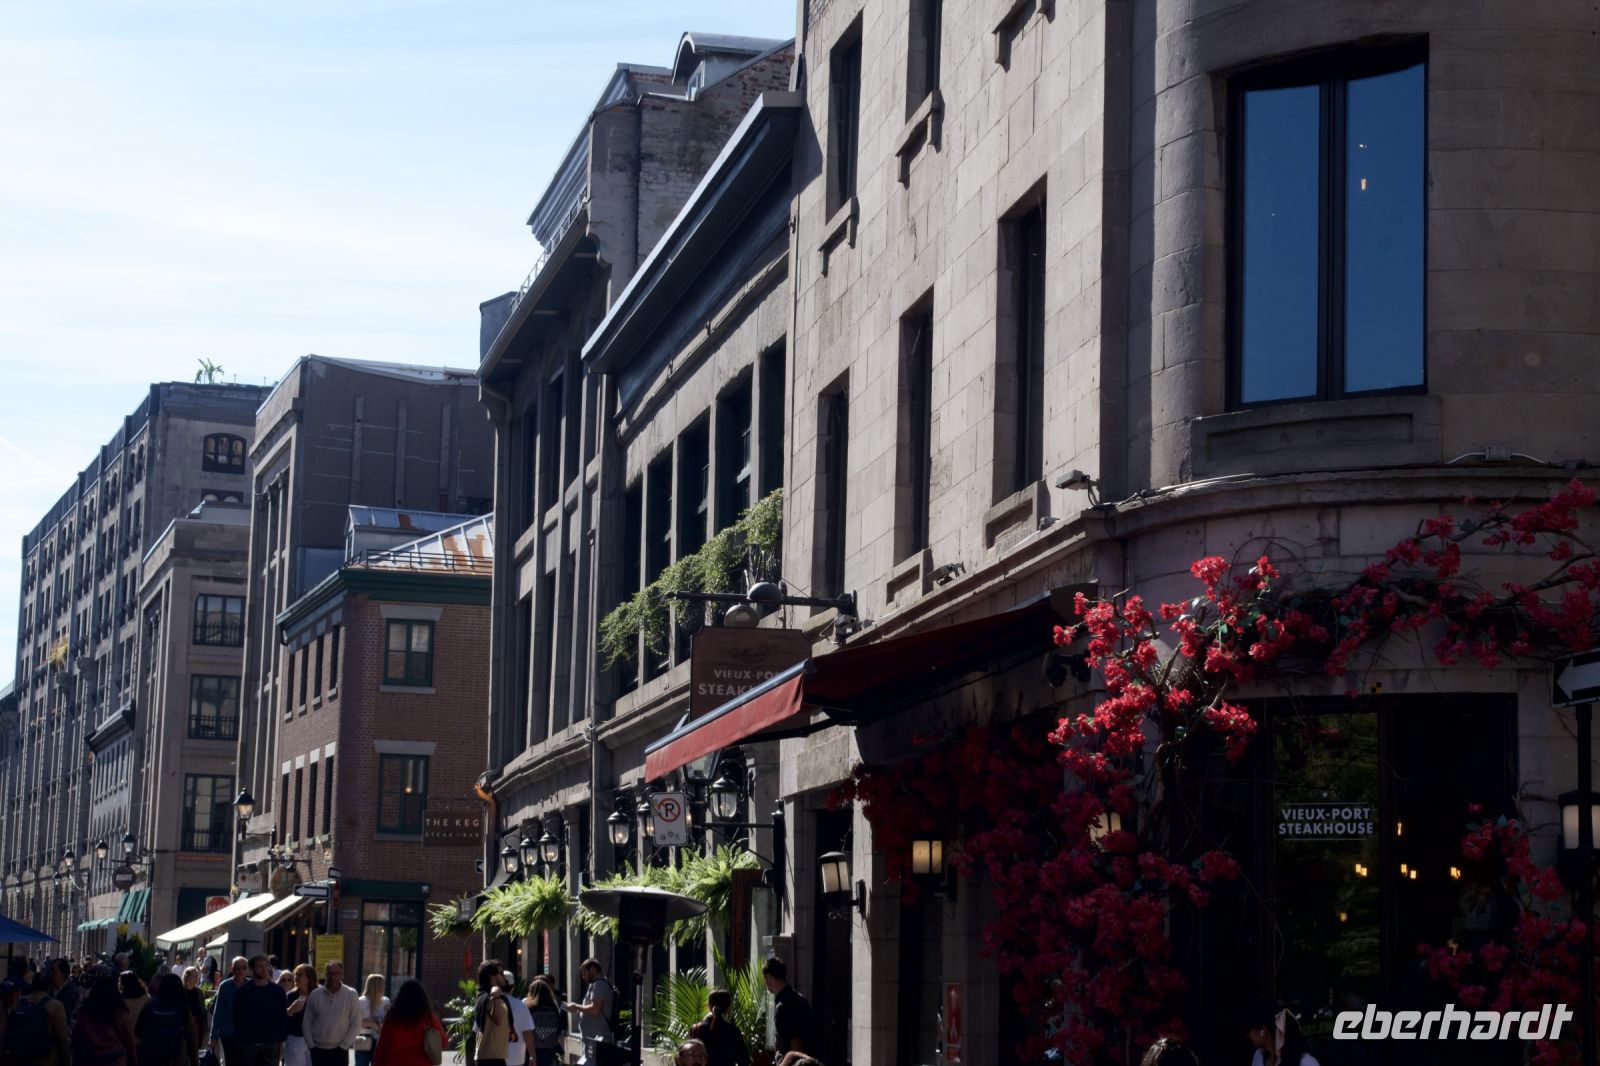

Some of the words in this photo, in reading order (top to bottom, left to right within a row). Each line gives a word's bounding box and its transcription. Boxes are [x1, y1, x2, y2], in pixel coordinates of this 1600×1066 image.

[713, 668, 779, 680] VIEUX-PO
[698, 683, 753, 696] STEAK
[1281, 807, 1370, 820] VIEUX-PORT
[425, 818, 449, 827] THE
[455, 818, 480, 827] KEG
[1278, 822, 1374, 835] STEAKHOUSE
